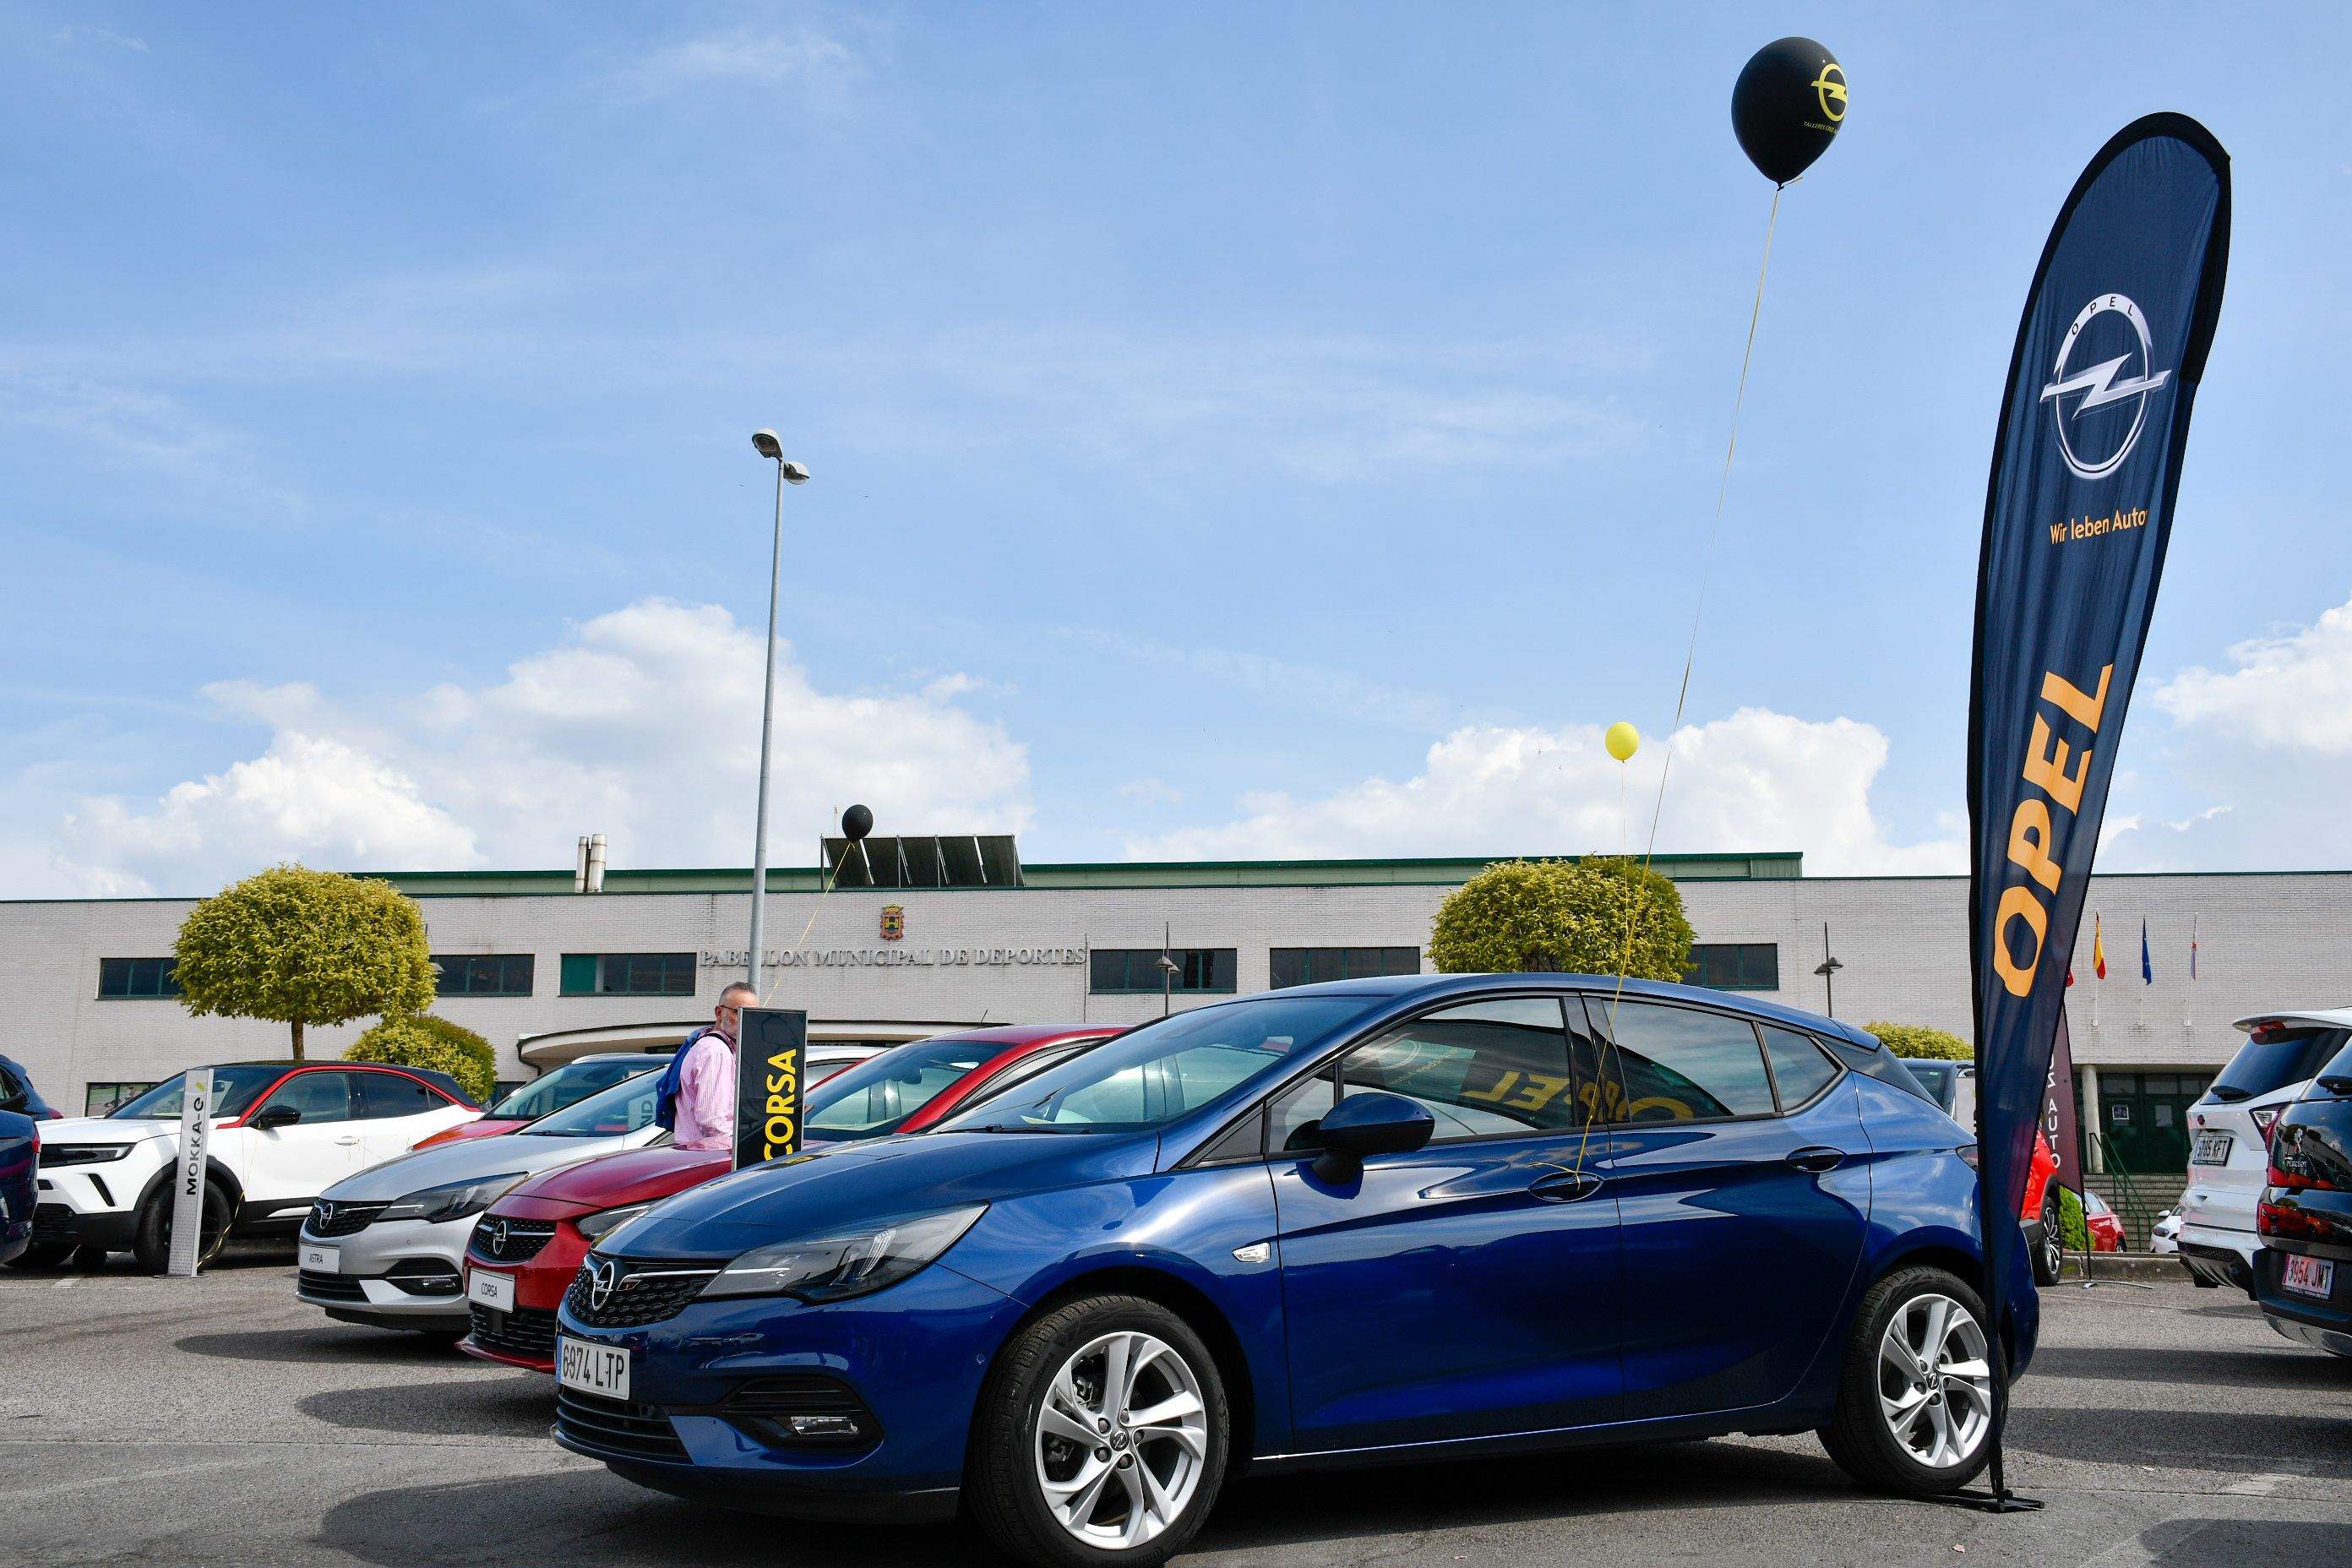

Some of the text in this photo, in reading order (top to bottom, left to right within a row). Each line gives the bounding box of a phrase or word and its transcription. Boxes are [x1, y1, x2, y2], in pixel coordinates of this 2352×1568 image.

[1803, 121, 1826, 130] TALLERES
[2072, 296, 2133, 336] OPEL
[2050, 506, 2148, 546] Wir leben Auto
[1993, 663, 2114, 998] OPEL
[700, 948, 1087, 967] PABELON MUNICIPAL DE DEPORTES
[764, 1048, 797, 1161] CORSA
[309, 1253, 324, 1264] ASTRA
[482, 1282, 498, 1298] CORSA
[563, 1343, 625, 1391] 6974 LTP
